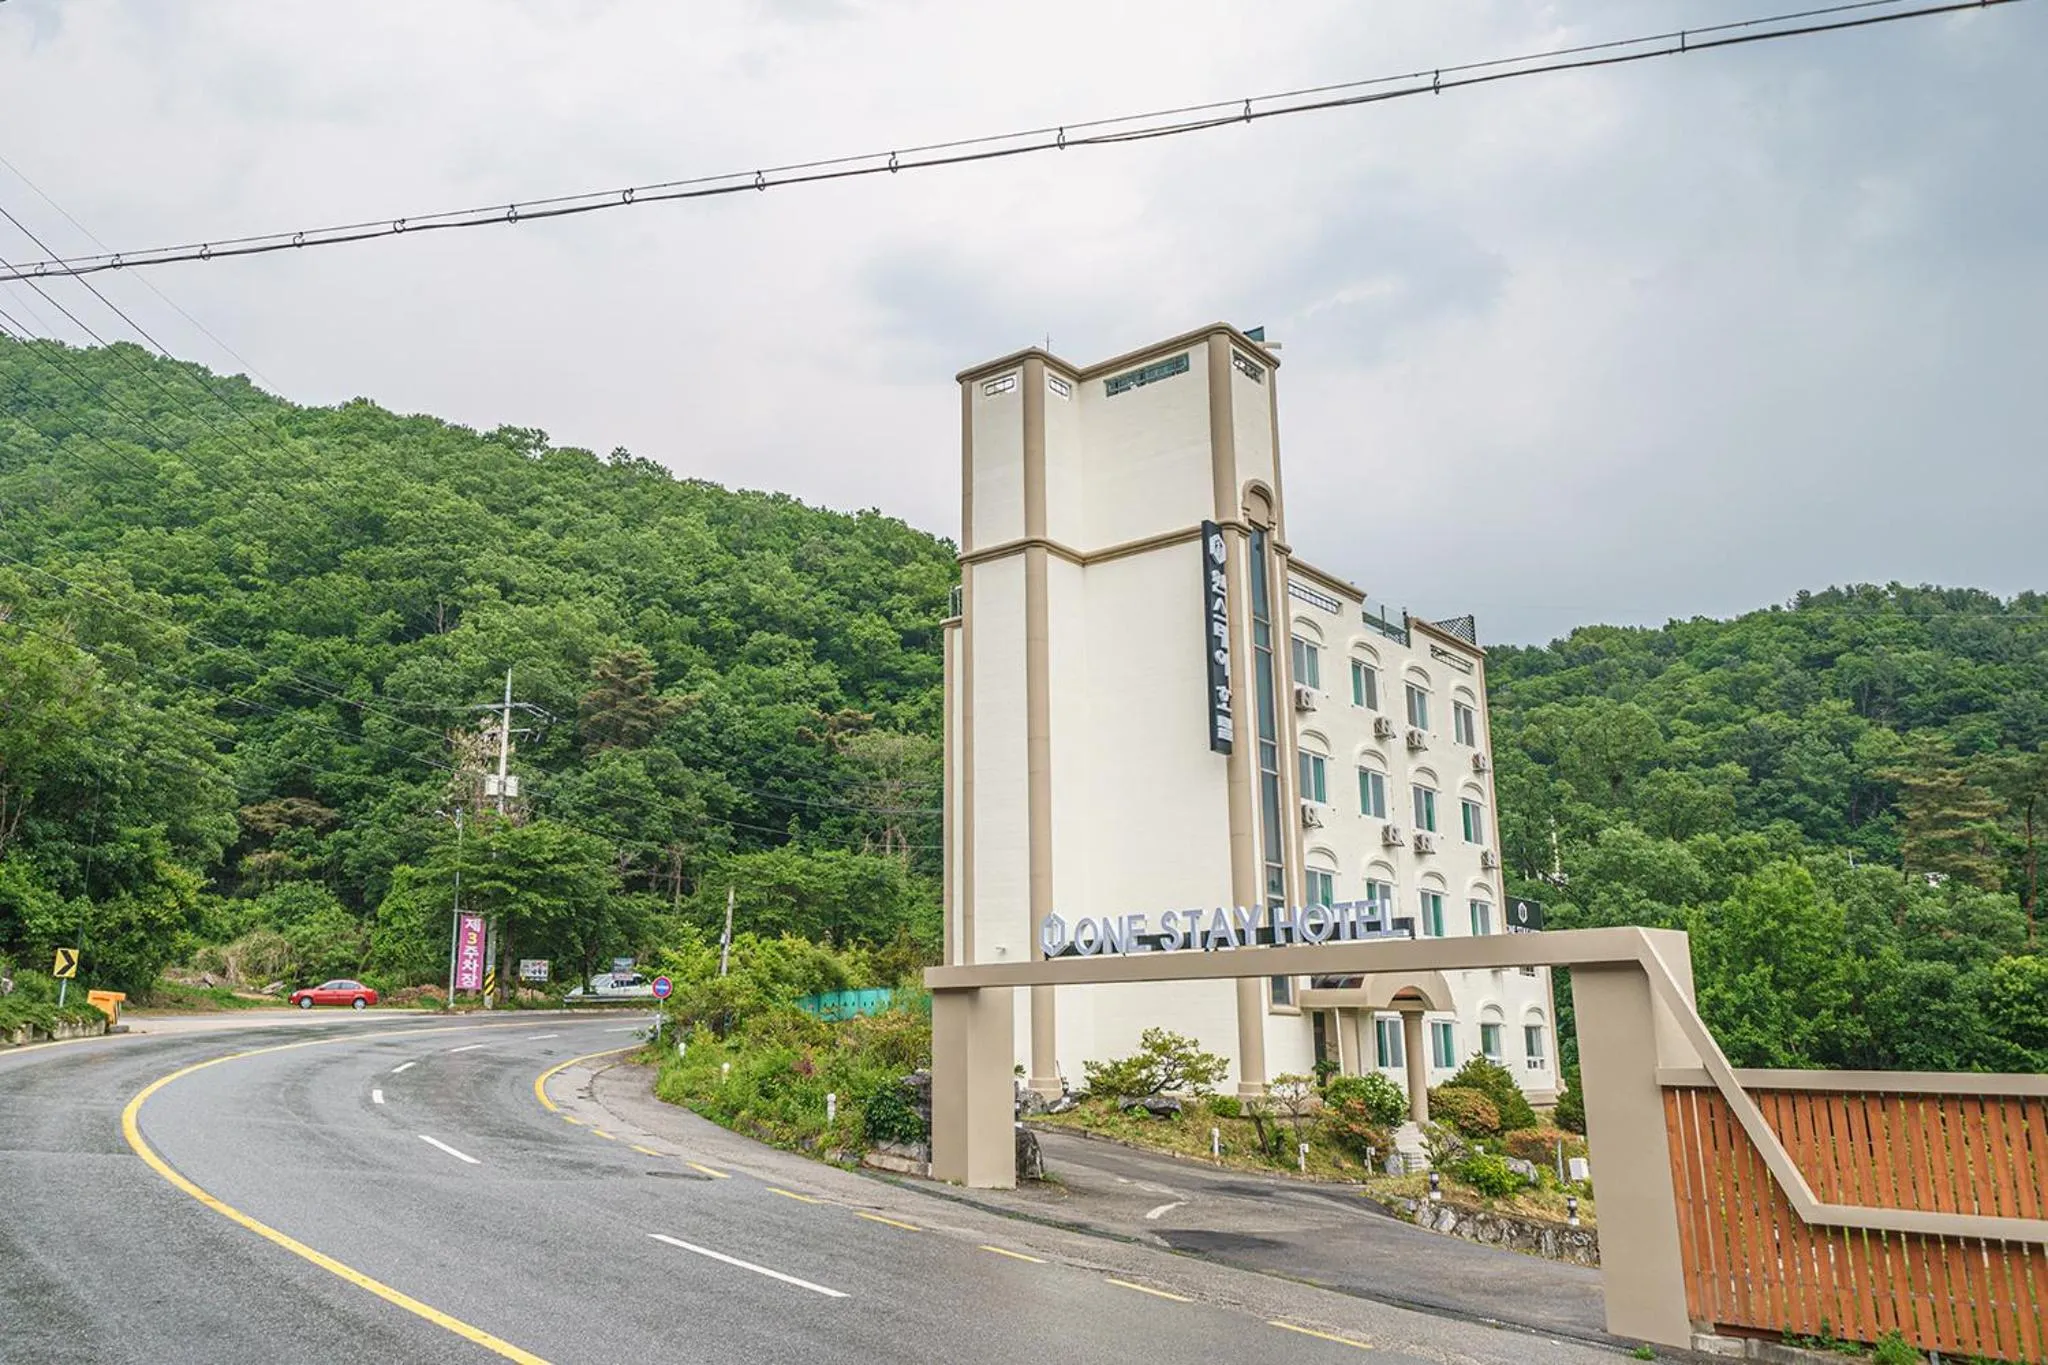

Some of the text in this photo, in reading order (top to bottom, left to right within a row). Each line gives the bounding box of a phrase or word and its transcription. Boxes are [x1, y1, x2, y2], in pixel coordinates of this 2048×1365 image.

[461, 918, 482, 988] 제3주차장
[1074, 898, 1410, 956] ONE STAY HOTEL
